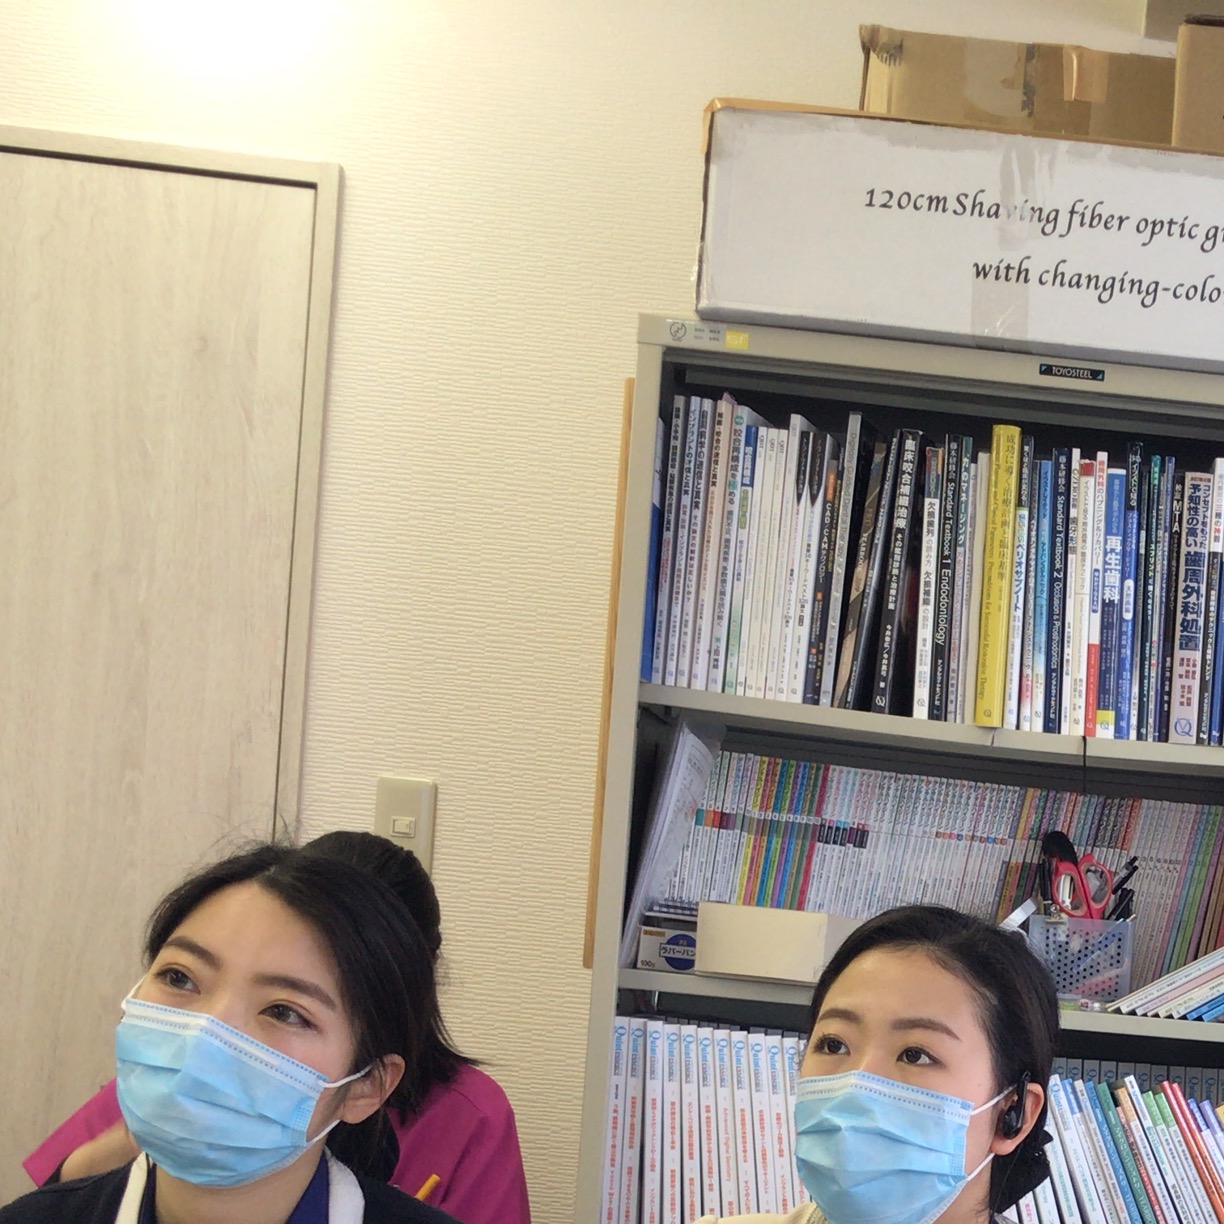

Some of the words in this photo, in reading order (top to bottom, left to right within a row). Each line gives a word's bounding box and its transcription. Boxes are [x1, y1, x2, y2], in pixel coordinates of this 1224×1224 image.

[864, 188, 948, 214] 120cm
[1059, 203, 1131, 237] fiber
[1135, 213, 1199, 245] optic
[973, 256, 1031, 285] with
[1051, 366, 1092, 378] TOYOSTEEL
[946, 482, 955, 518] Standard
[1056, 496, 1065, 530] Standard
[1172, 500, 1182, 532] MTA
[1185, 483, 1201, 548] 予知性の高い
[943, 521, 953, 556] Textbook
[1053, 533, 1063, 569] Textbook
[1103, 536, 1122, 603] 再生歯科
[935, 568, 951, 646] Endodontology
[1053, 581, 1062, 614] Occlusion
[1178, 551, 1206, 652] 歯周外科処置
